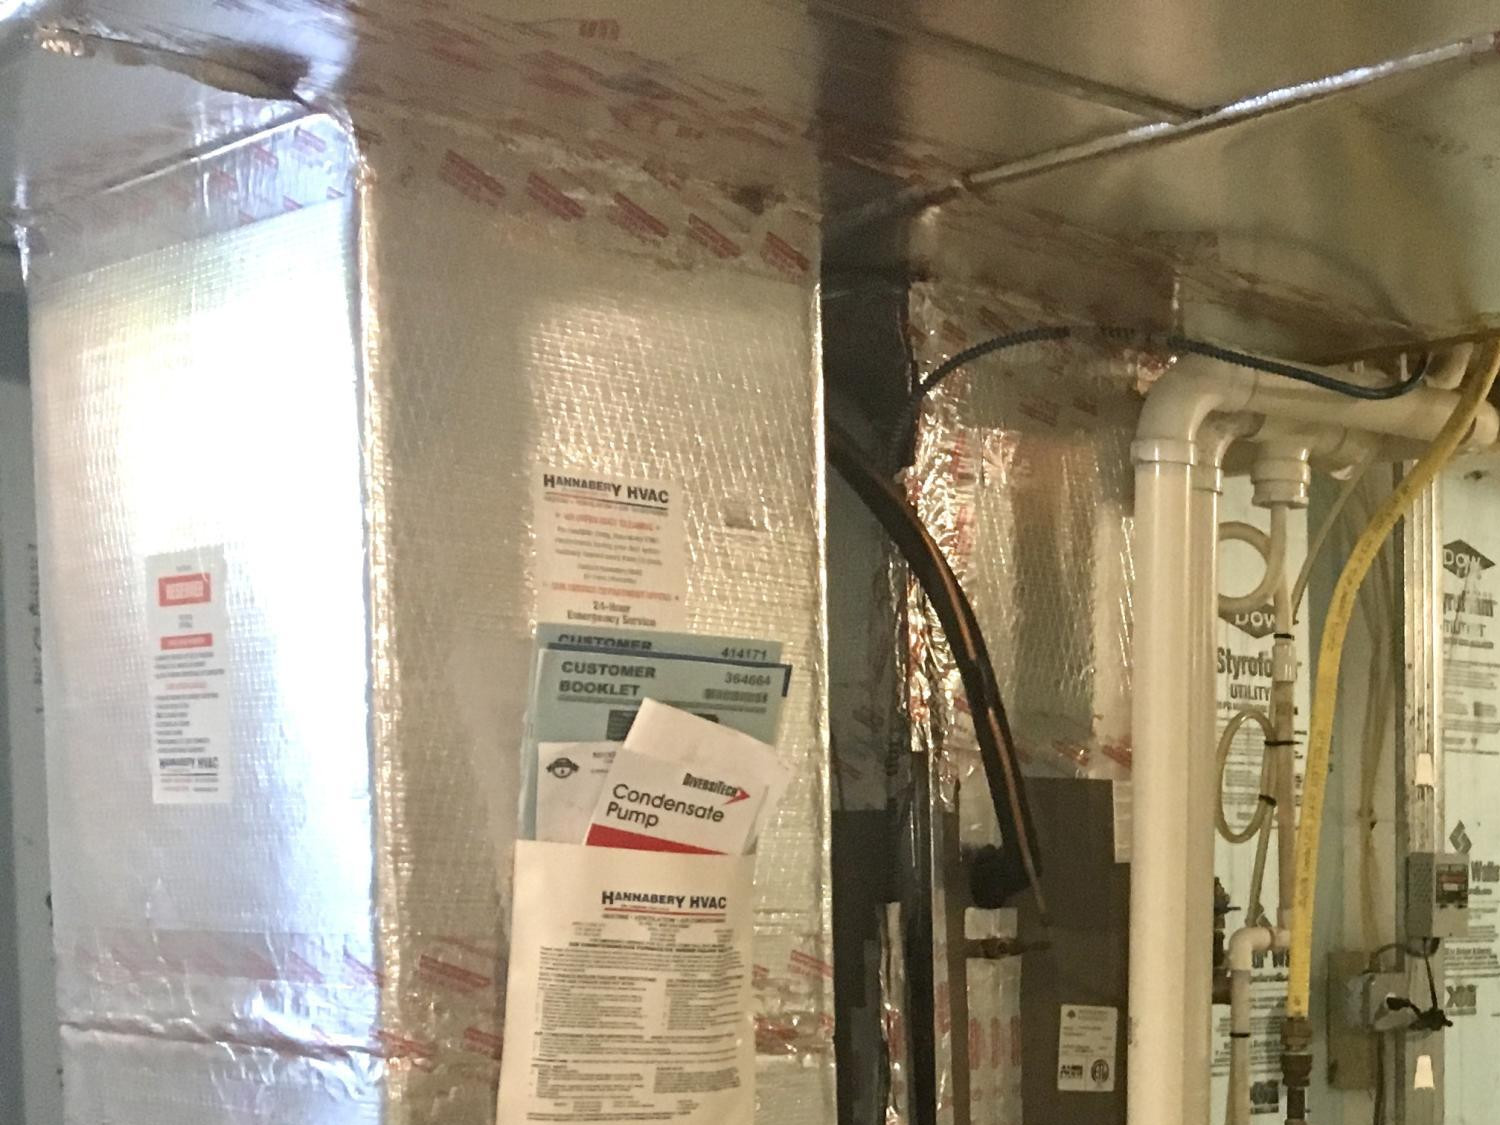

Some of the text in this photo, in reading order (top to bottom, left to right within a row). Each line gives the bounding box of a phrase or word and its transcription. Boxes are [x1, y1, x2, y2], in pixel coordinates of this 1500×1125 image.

[543, 474, 670, 504] HANNABERY HVAC
[592, 601, 631, 613] 24-Hour
[567, 610, 656, 627] Emergency Service
[561, 660, 656, 679] CUSTOMER
[1217, 647, 1272, 680] Styrofo
[559, 680, 640, 696] BOOKLET
[1230, 684, 1271, 701] UTILITY
[612, 784, 724, 823] Condensate
[606, 801, 659, 828] Pump
[602, 891, 727, 909] HANNABERY HVAC
